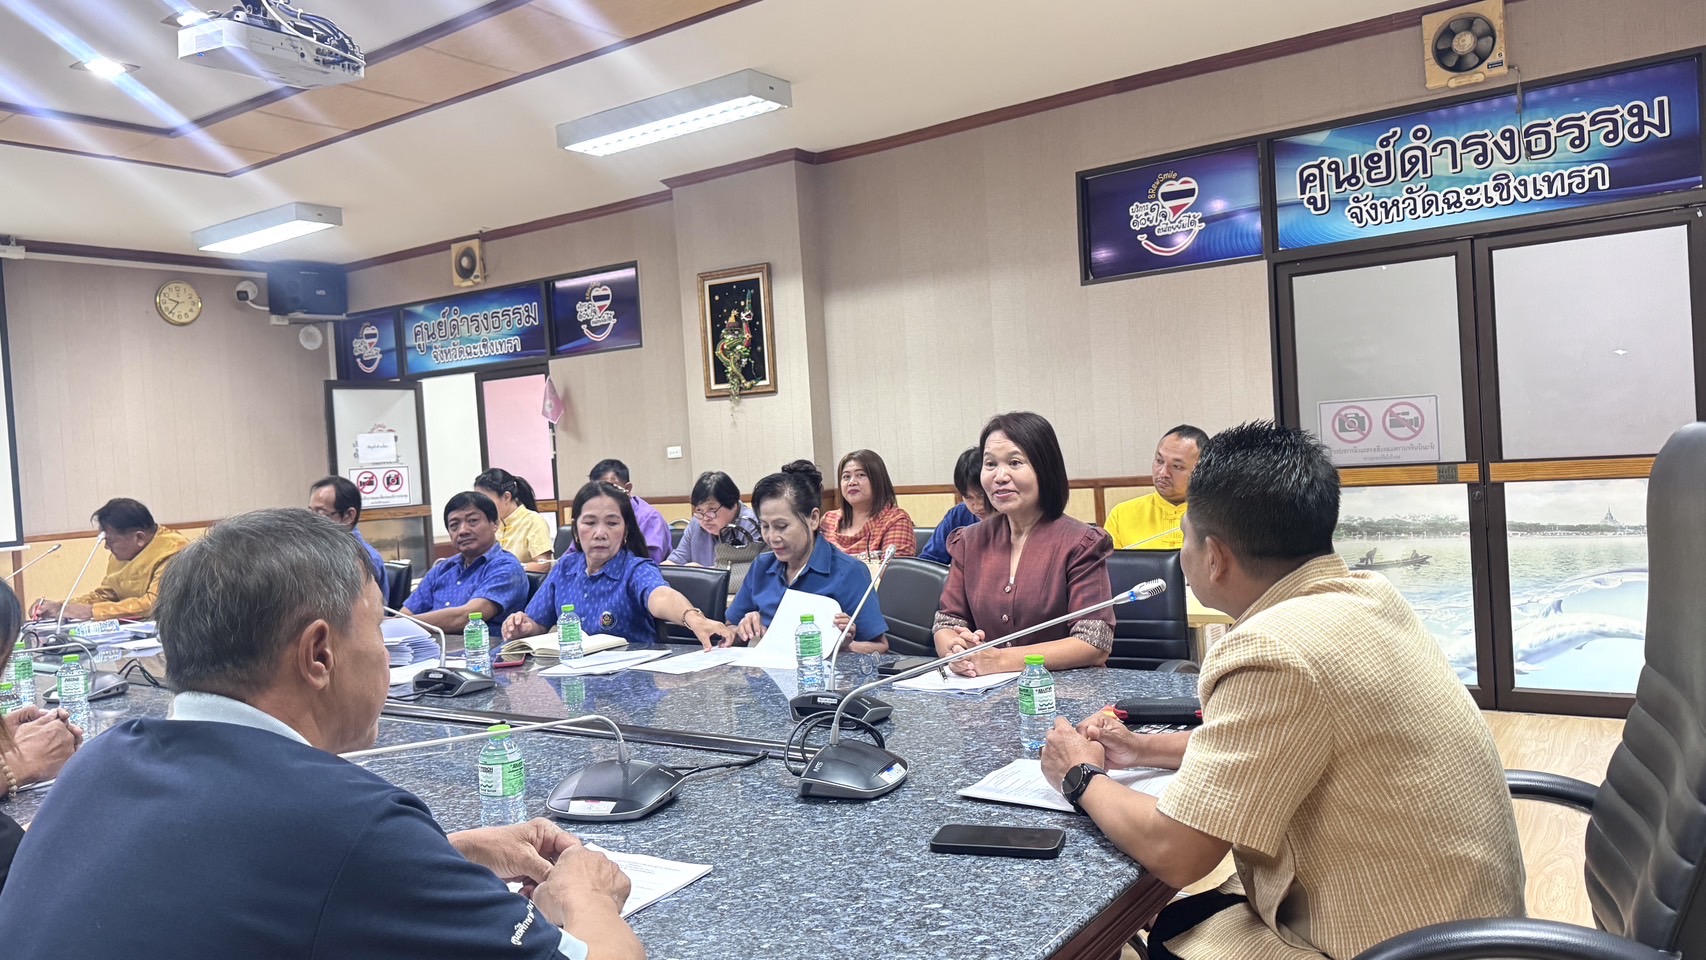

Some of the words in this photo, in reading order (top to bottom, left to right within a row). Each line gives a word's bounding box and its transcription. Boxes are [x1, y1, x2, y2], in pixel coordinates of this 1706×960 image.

[1298, 97, 1669, 214] ศูนย์ดำรงธรรม
[1346, 164, 1609, 227] จังหวัดฉะเชิงเทรา
[413, 302, 539, 355] ศูนย์ดำรงธรรม
[432, 337, 521, 364] จังหวัดฉะเชิงเทรา
